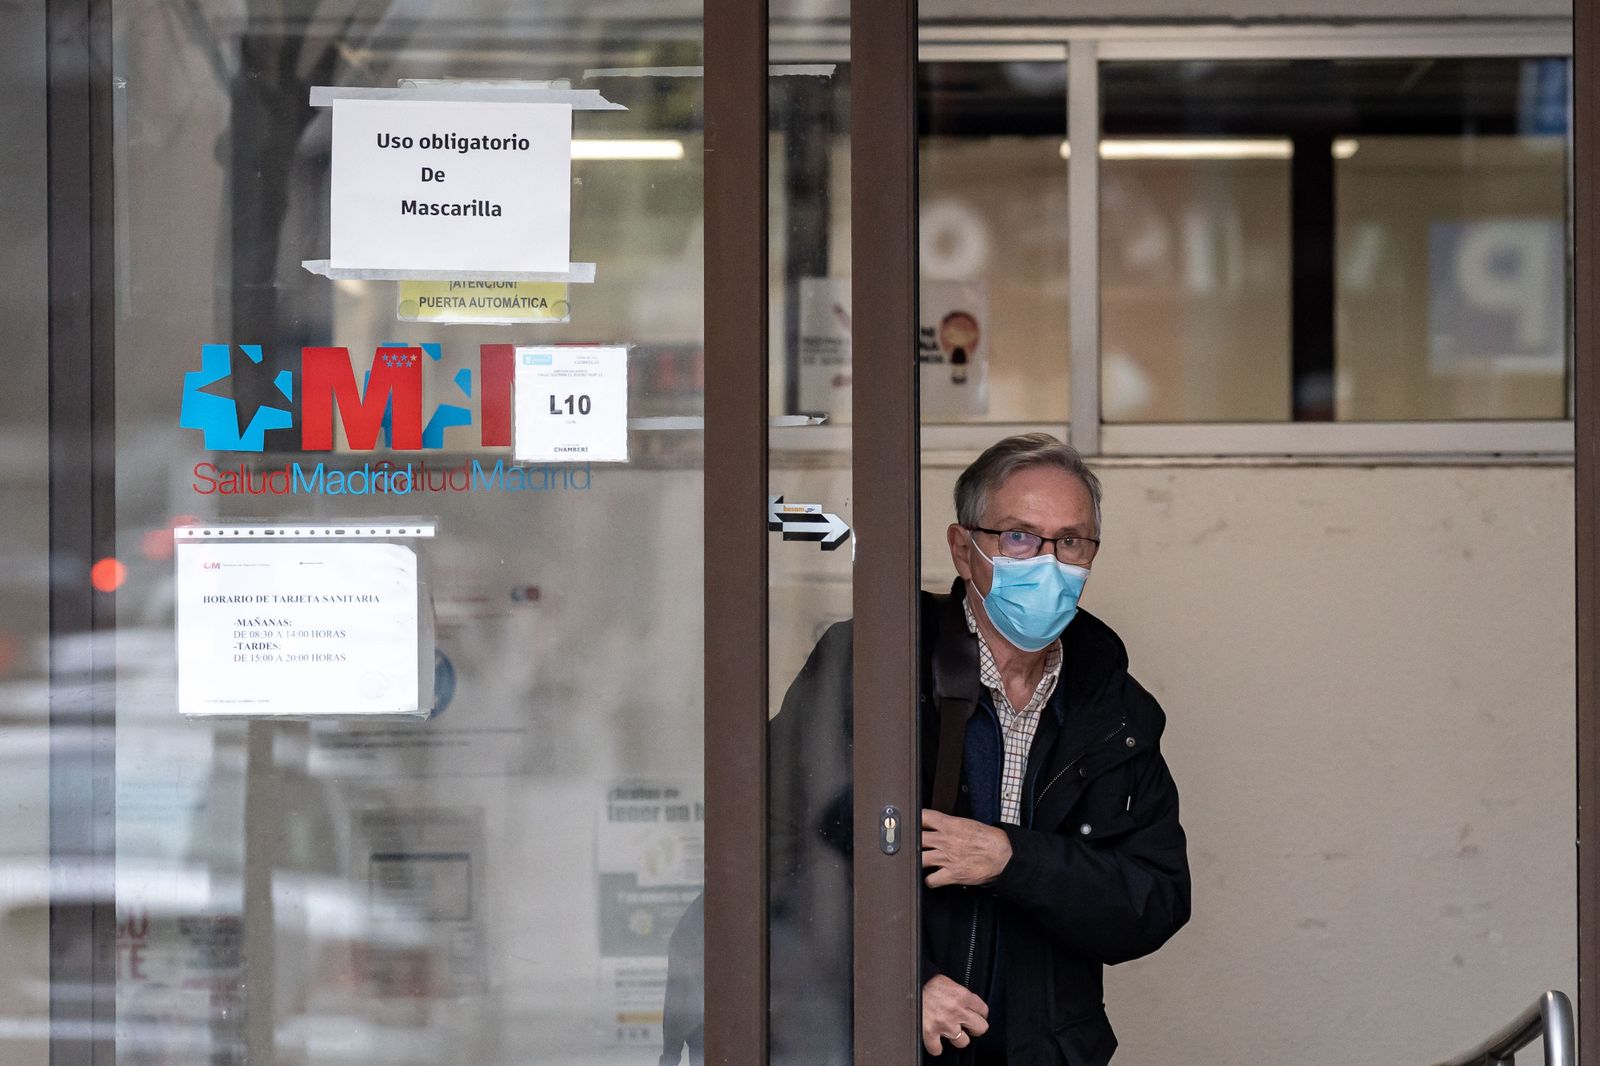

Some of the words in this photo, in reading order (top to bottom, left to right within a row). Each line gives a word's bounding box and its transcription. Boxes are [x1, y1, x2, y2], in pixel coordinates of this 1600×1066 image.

[377, 133, 413, 149] Uso
[419, 133, 530, 153] obligatorio
[421, 167, 445, 182] De
[401, 200, 502, 217] Mascarilla
[419, 296, 465, 308] PUERTA
[469, 294, 548, 309] AUTOMÁTICA
[549, 394, 591, 415] L10
[203, 595, 253, 604] HORARIO
[255, 595, 270, 603] DE
[272, 595, 320, 603] TARJETA
[322, 595, 380, 603] SANITARIA
[233, 617, 292, 627] -MAÑANAS:
[233, 630, 247, 639] DE
[249, 630, 273, 639] 08:30
[275, 630, 283, 638] A
[286, 630, 309, 638] 14:00
[311, 630, 346, 638] HORAS
[233, 642, 281, 651] -TARDES:
[233, 654, 247, 662] DE
[250, 654, 273, 662] 15:00
[275, 654, 283, 662] A
[286, 653, 309, 662] 20:00
[311, 653, 346, 662] HORAS
